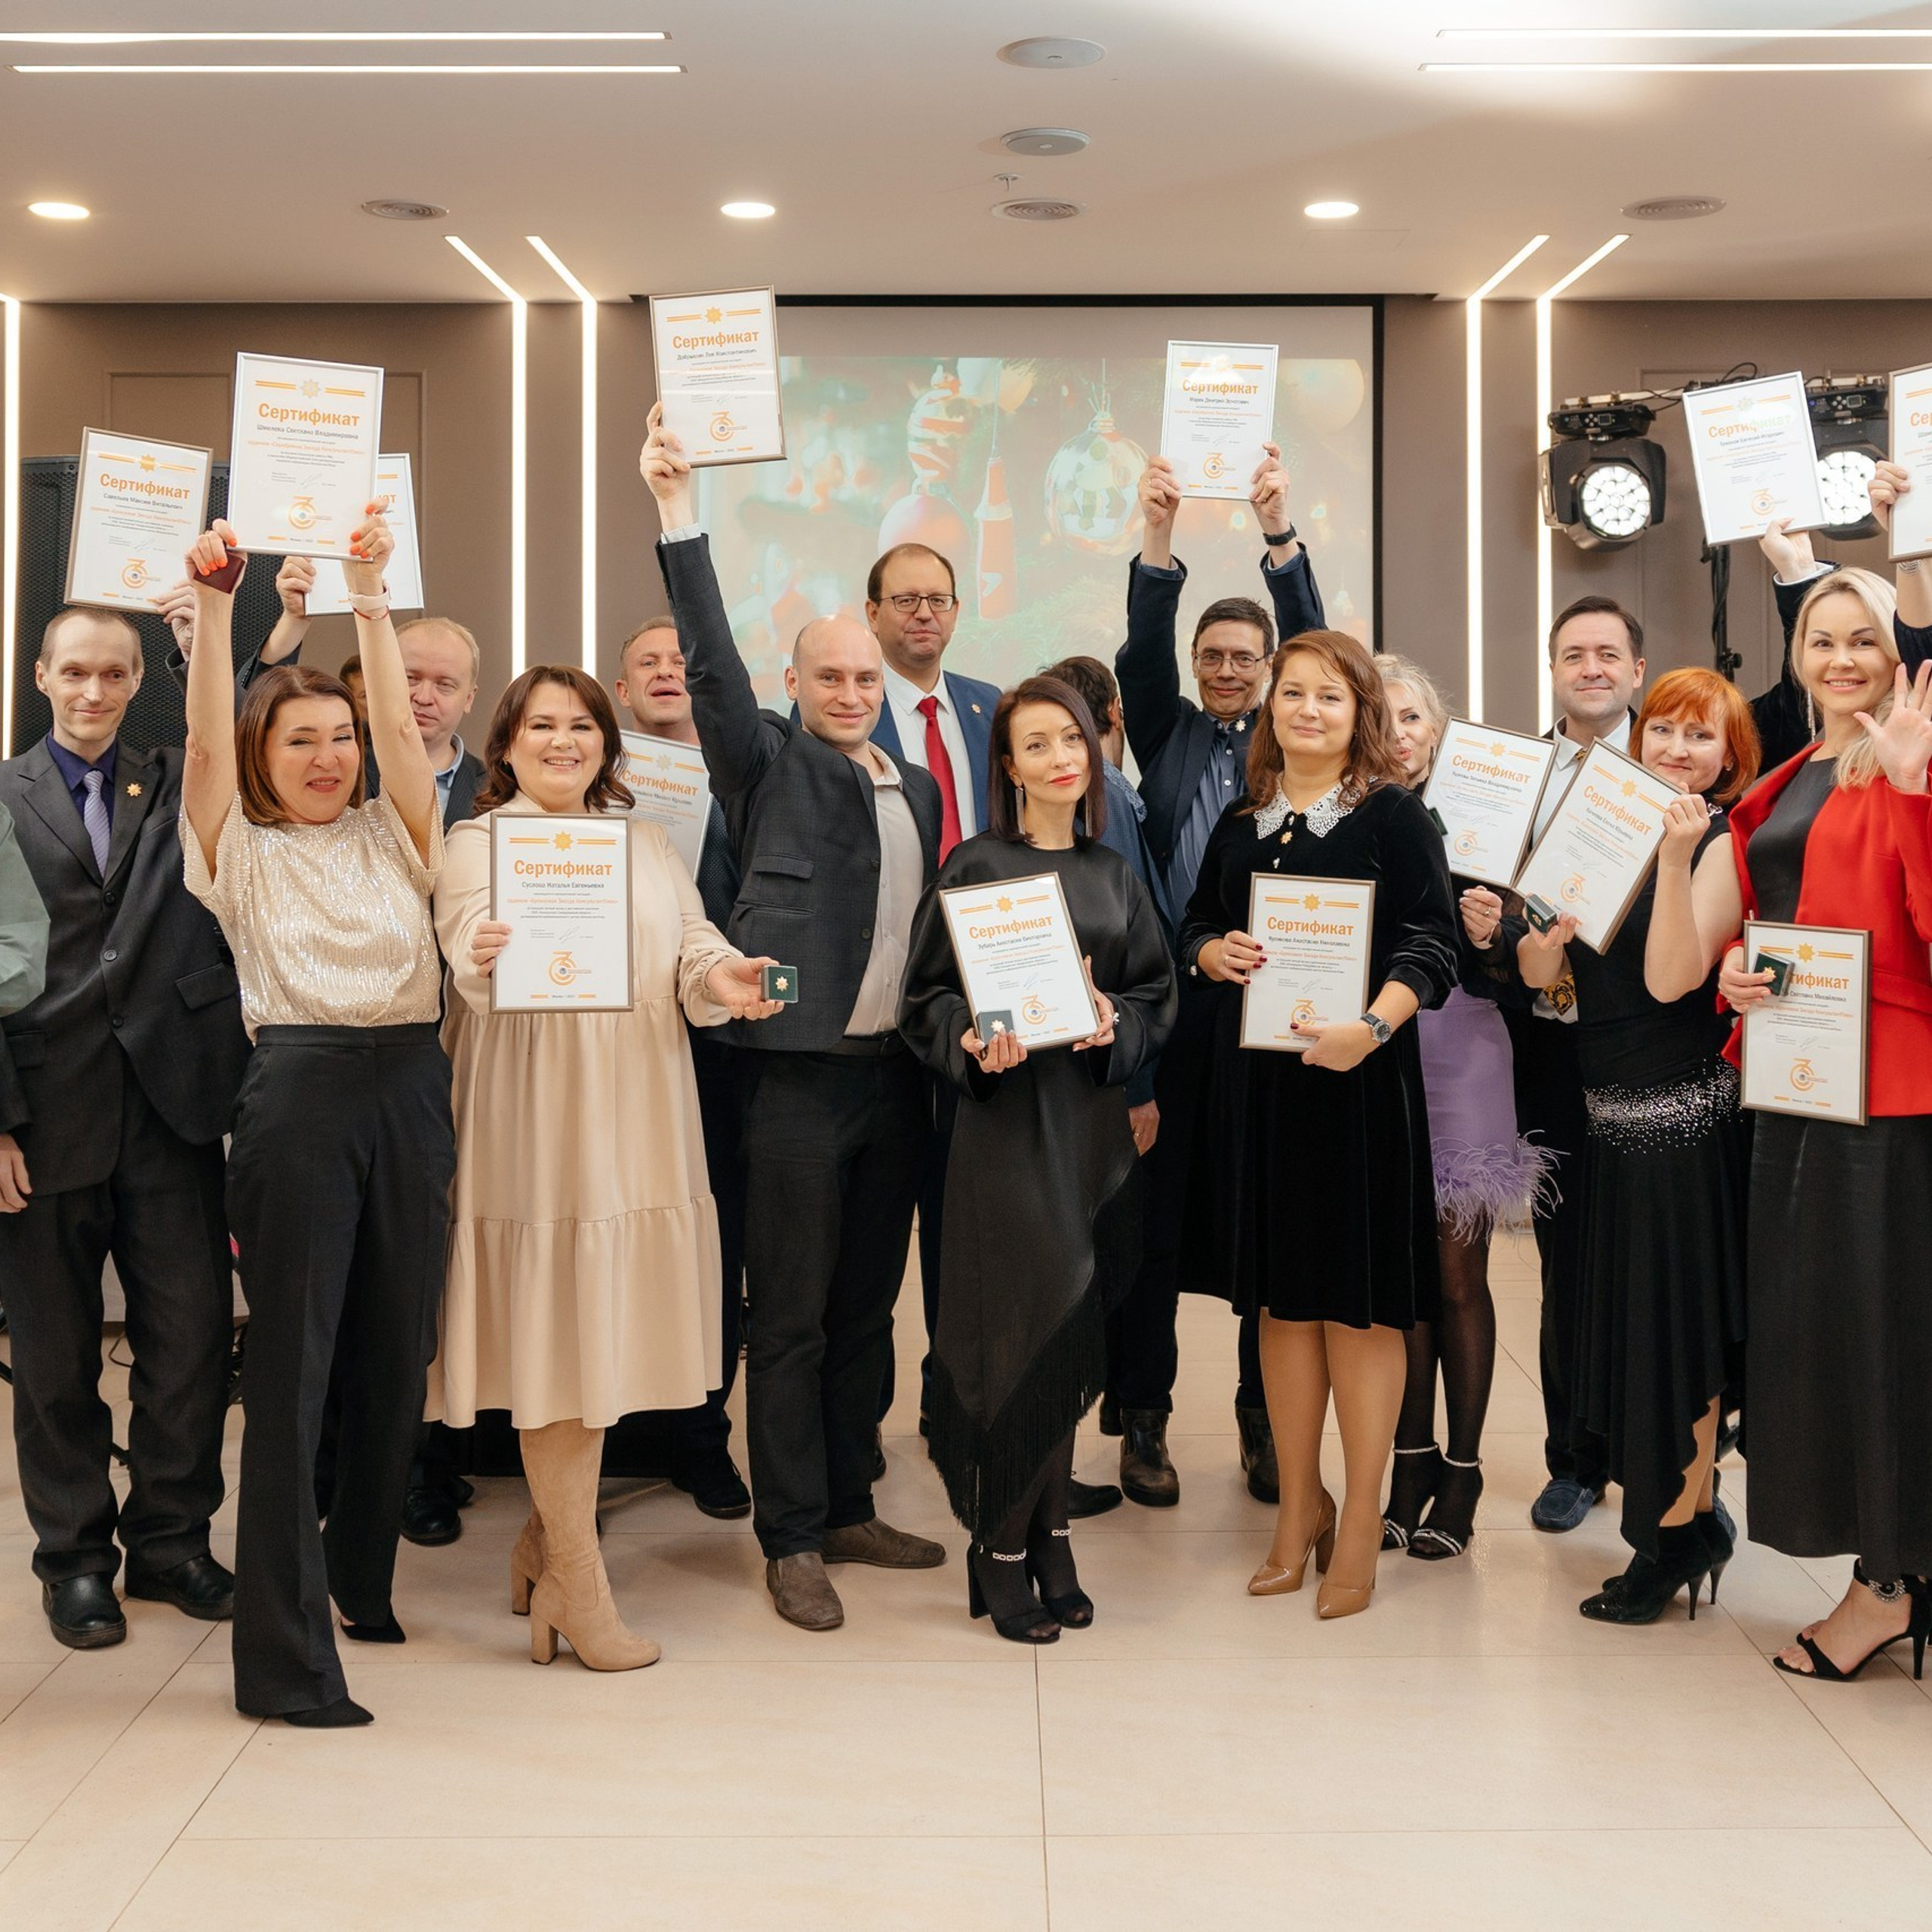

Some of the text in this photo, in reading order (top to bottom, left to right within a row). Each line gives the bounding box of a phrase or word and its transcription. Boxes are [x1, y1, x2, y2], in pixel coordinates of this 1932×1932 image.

[672, 331, 758, 350] Сертификат
[1183, 380, 1259, 395] Сертификат
[258, 402, 360, 426] Сертификат
[1910, 412, 1932, 426] Се
[286, 426, 313, 435] Светлана
[315, 430, 358, 439] Владимировна
[1709, 414, 1791, 438] Сертификат
[100, 473, 190, 500] Сертификат
[1452, 754, 1531, 784] Сертификат
[622, 769, 699, 796] Сертификат
[1583, 785, 1653, 835] Сертификат
[514, 859, 612, 878] Сертификат
[521, 881, 545, 890] Суслова
[969, 915, 1053, 940] Сертификат
[1267, 916, 1354, 936] Сертификат
[1790, 972, 1850, 989] тификат
